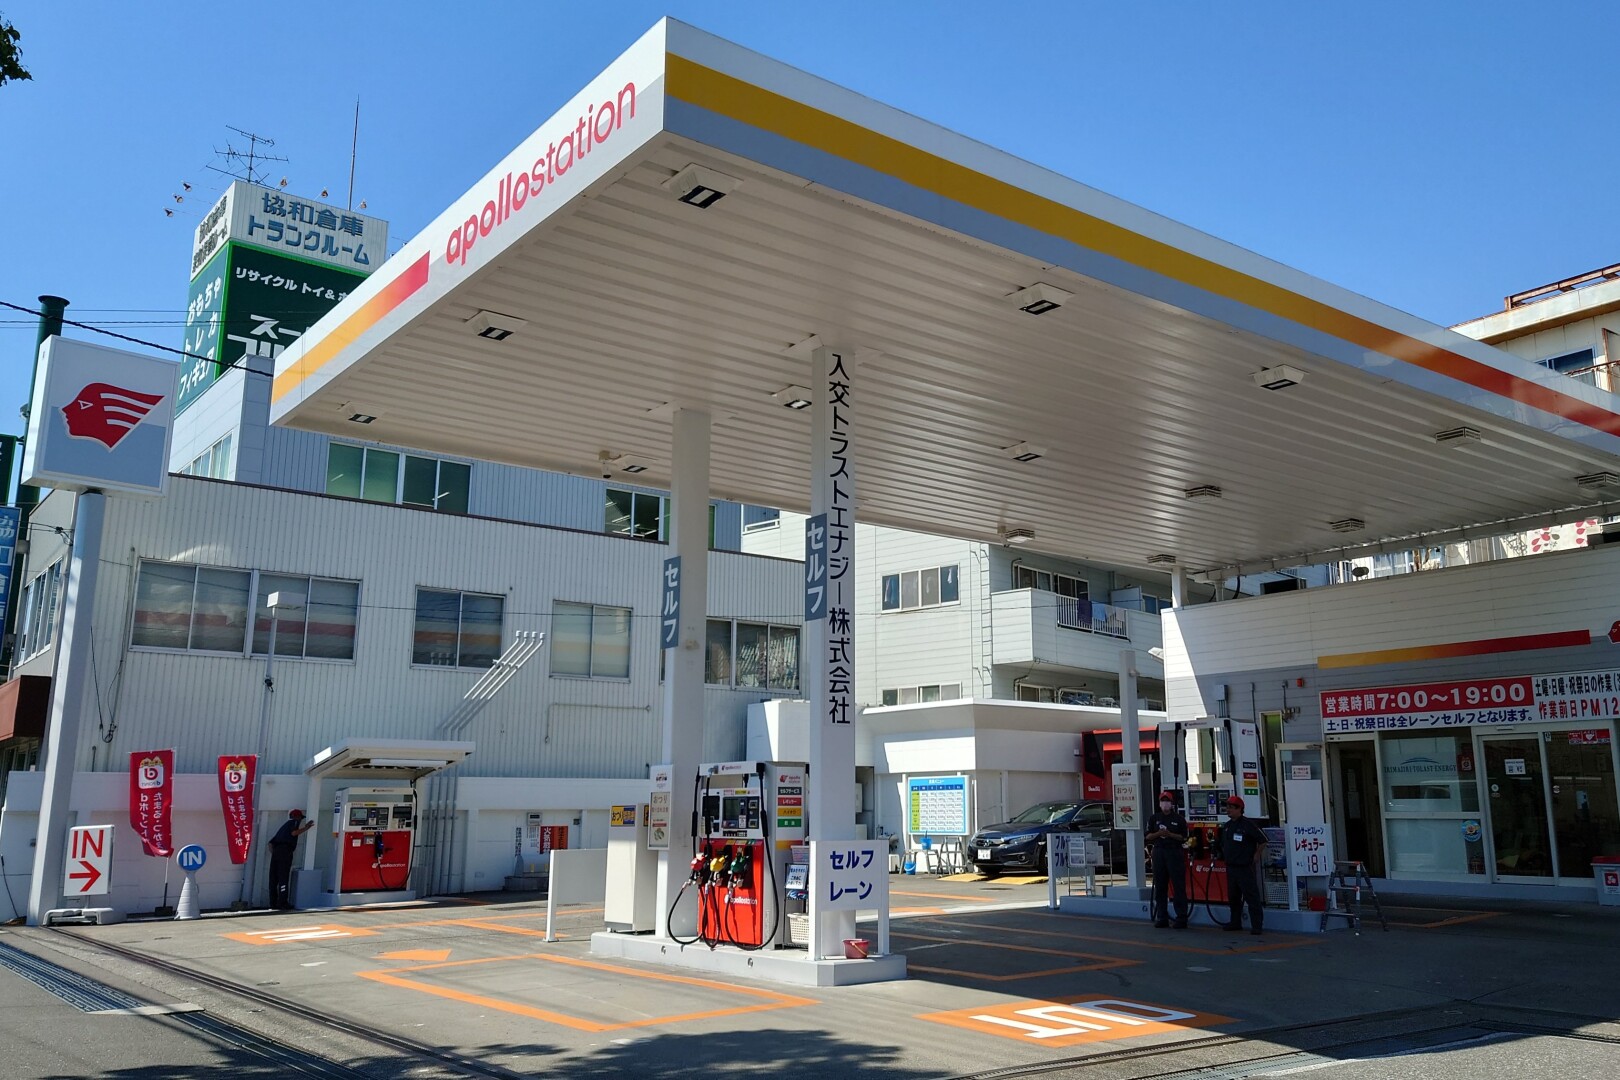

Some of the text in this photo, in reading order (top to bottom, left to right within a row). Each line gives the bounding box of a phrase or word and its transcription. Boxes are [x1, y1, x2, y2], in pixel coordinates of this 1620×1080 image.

[446, 82, 635, 265] apollostation
[262, 193, 365, 238] 協和倉庫
[248, 215, 370, 266] トランクルーム
[236, 266, 297, 292] リサイクル
[829, 353, 851, 724] 入交トラストエナジー株式会社
[807, 523, 825, 615] セルフ
[664, 563, 679, 642] セルフ
[71, 829, 104, 859] IN
[182, 851, 202, 867] IN
[830, 850, 874, 870] セルフ
[1295, 838, 1325, 851] レギュラー
[830, 881, 873, 902] レーン
